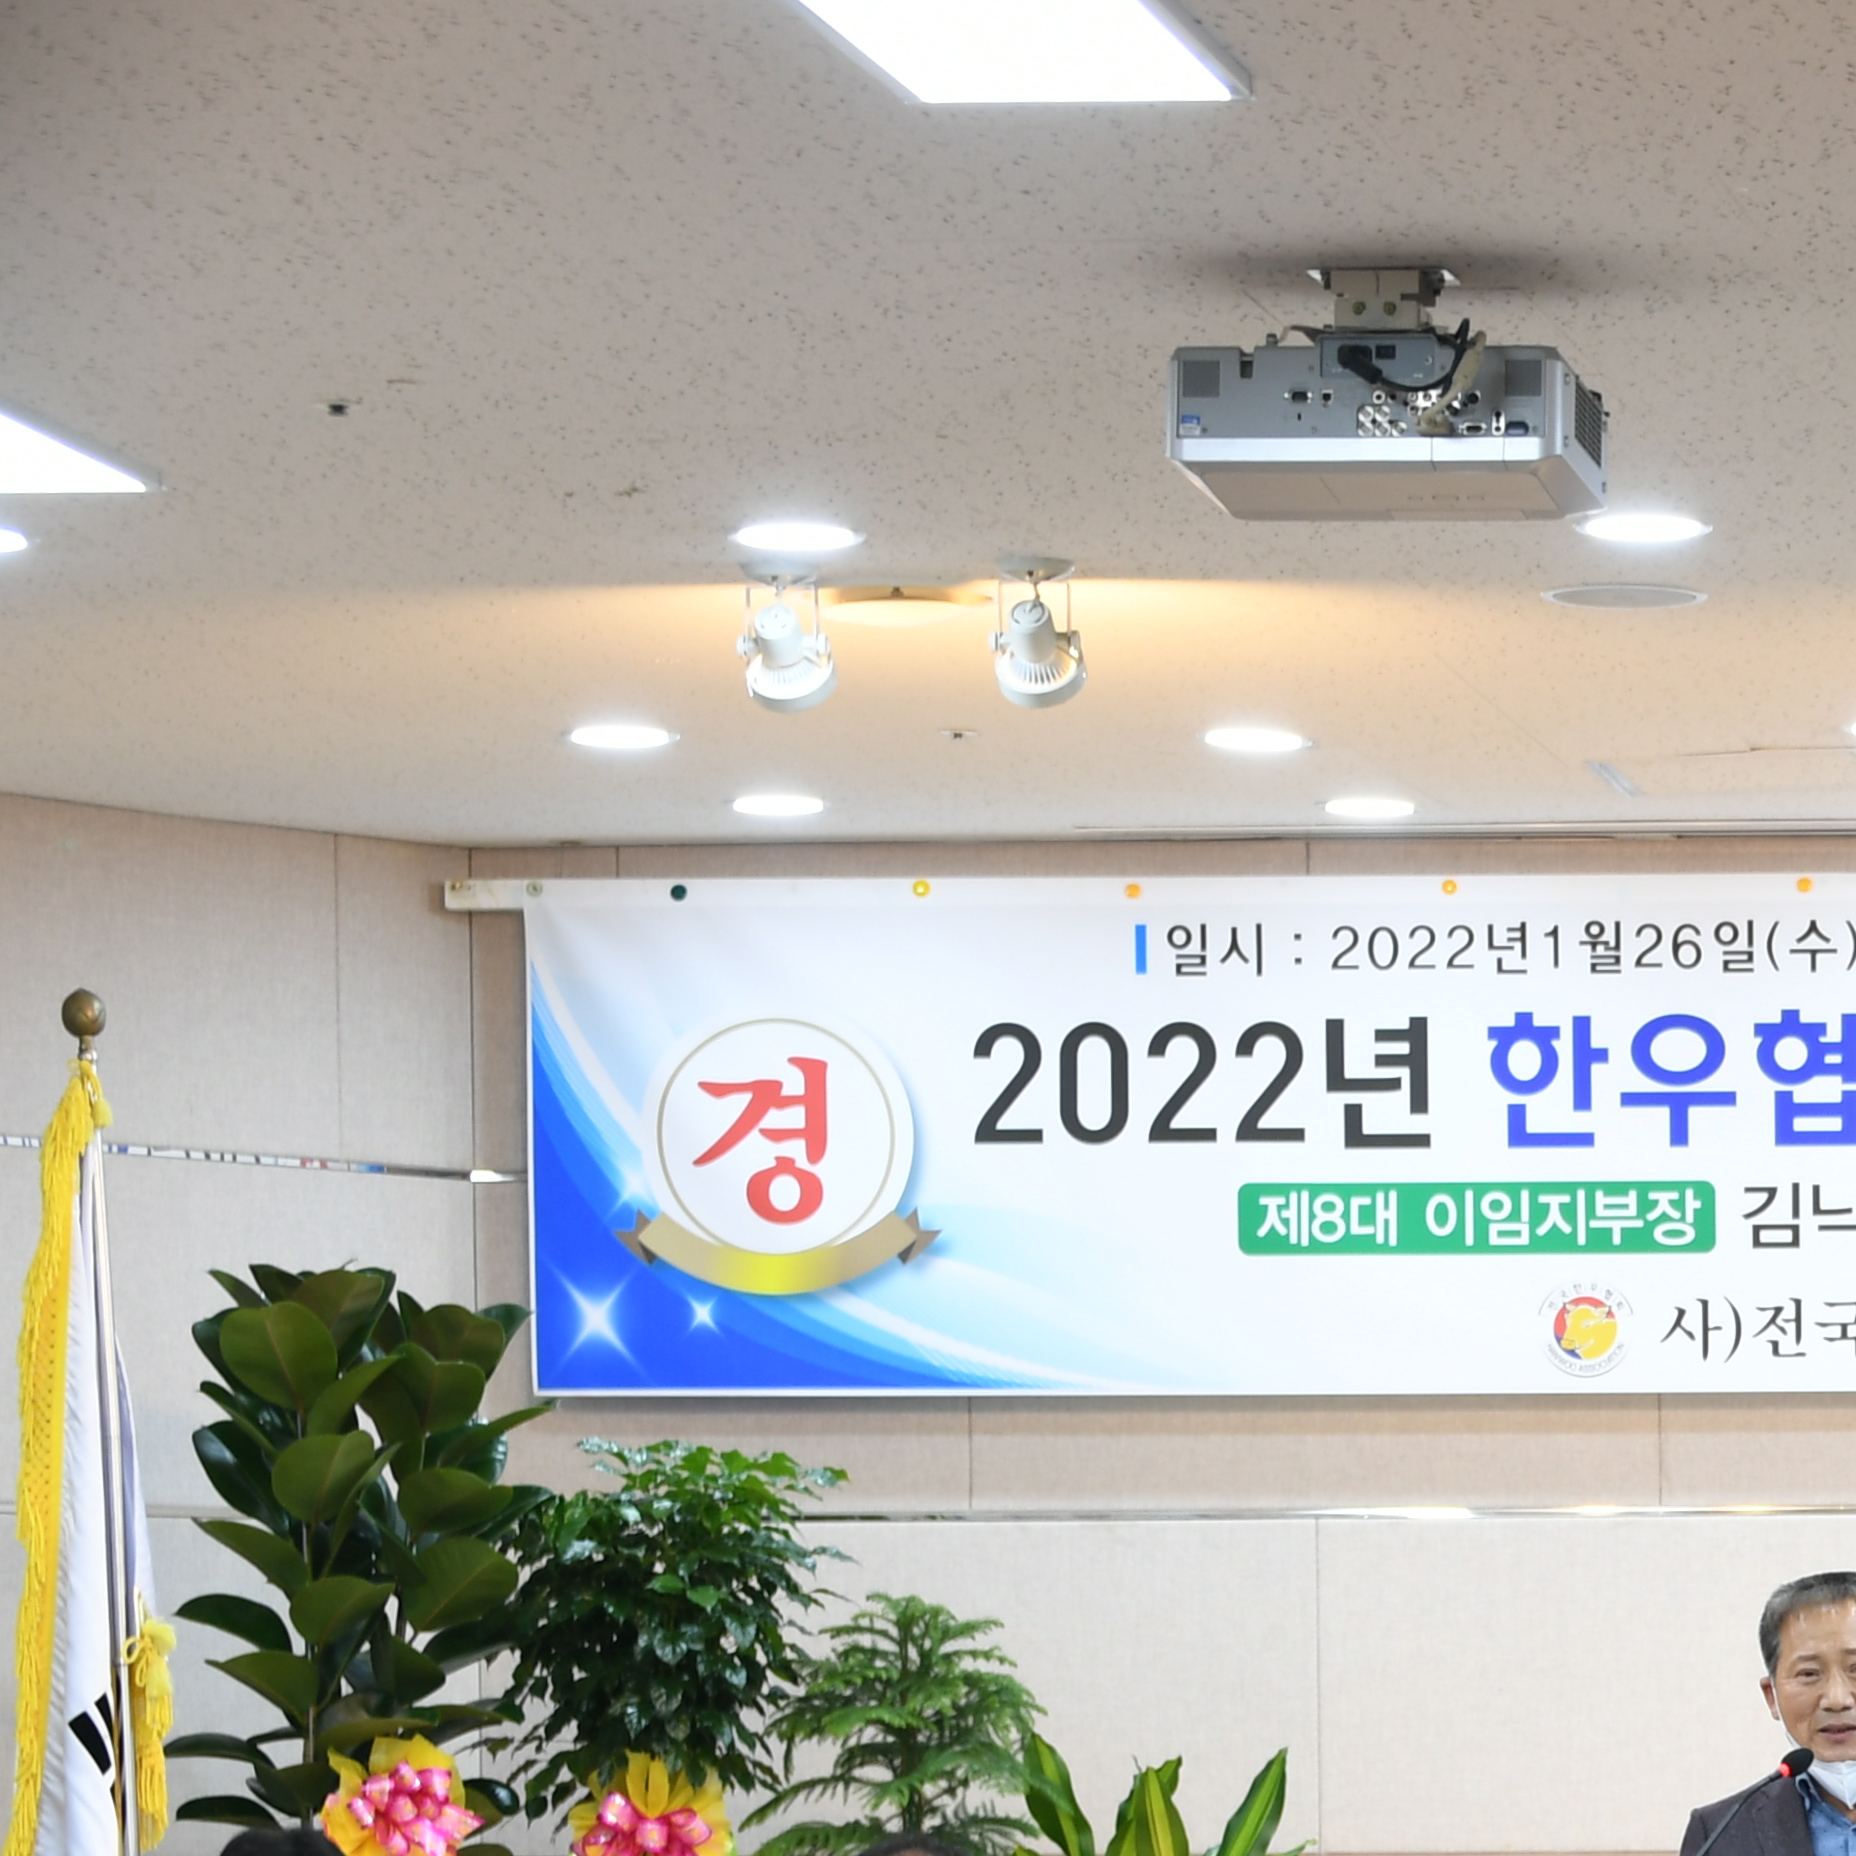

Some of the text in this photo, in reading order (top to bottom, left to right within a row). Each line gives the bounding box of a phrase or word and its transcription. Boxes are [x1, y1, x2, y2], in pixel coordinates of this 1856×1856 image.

[1165, 922, 1264, 977] 일시
[972, 1015, 1432, 1150] 2022년
[692, 1056, 829, 1225] 경
[1256, 1188, 1398, 1247] 제8대
[1424, 1188, 1702, 1246] 이임지부장
